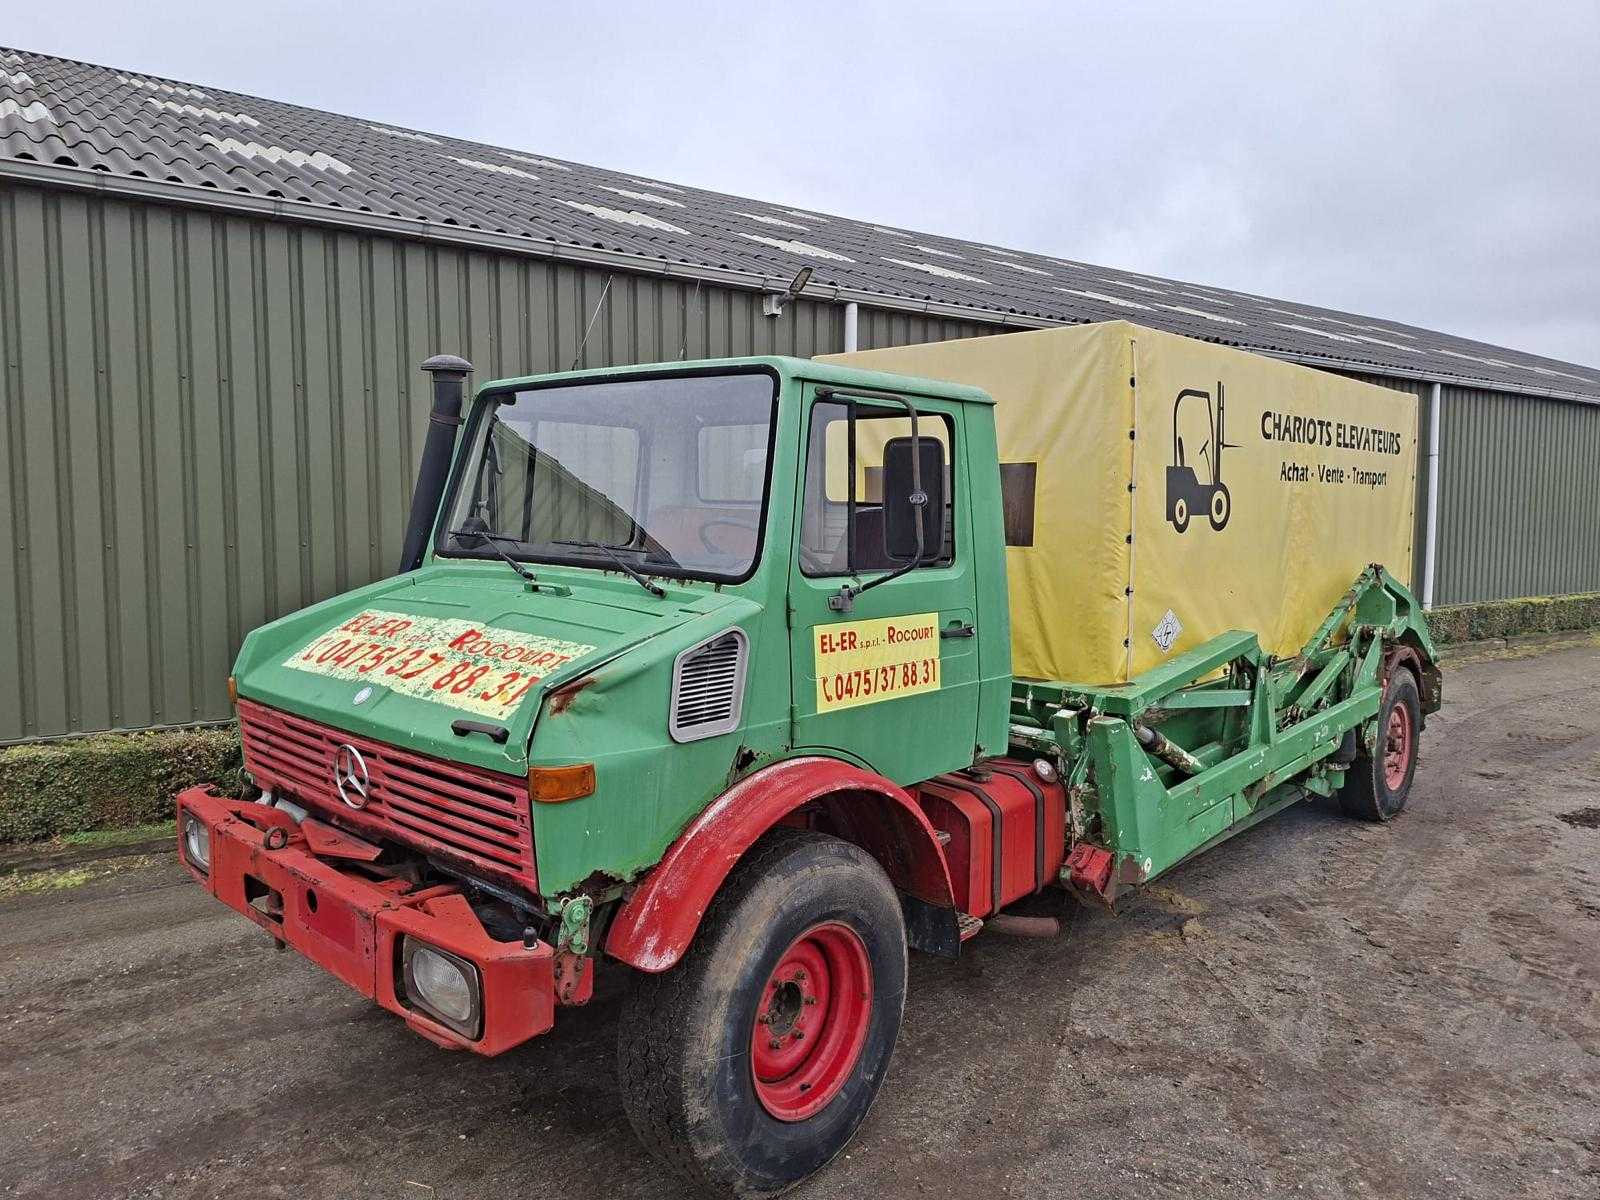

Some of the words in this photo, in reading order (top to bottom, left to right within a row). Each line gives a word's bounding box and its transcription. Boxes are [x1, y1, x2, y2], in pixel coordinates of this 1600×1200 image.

[1261, 410, 1332, 447] CHARIOTS
[1336, 422, 1401, 455] ELEVATEURS
[1280, 461, 1309, 482] Achat
[1317, 464, 1344, 484] Vente
[1352, 467, 1387, 489] Transport
[448, 629, 571, 669] ROCOURT
[820, 631, 857, 654] EL-ER
[887, 626, 934, 644] ROCOURT
[835, 658, 936, 700] 0475/37.88.31
